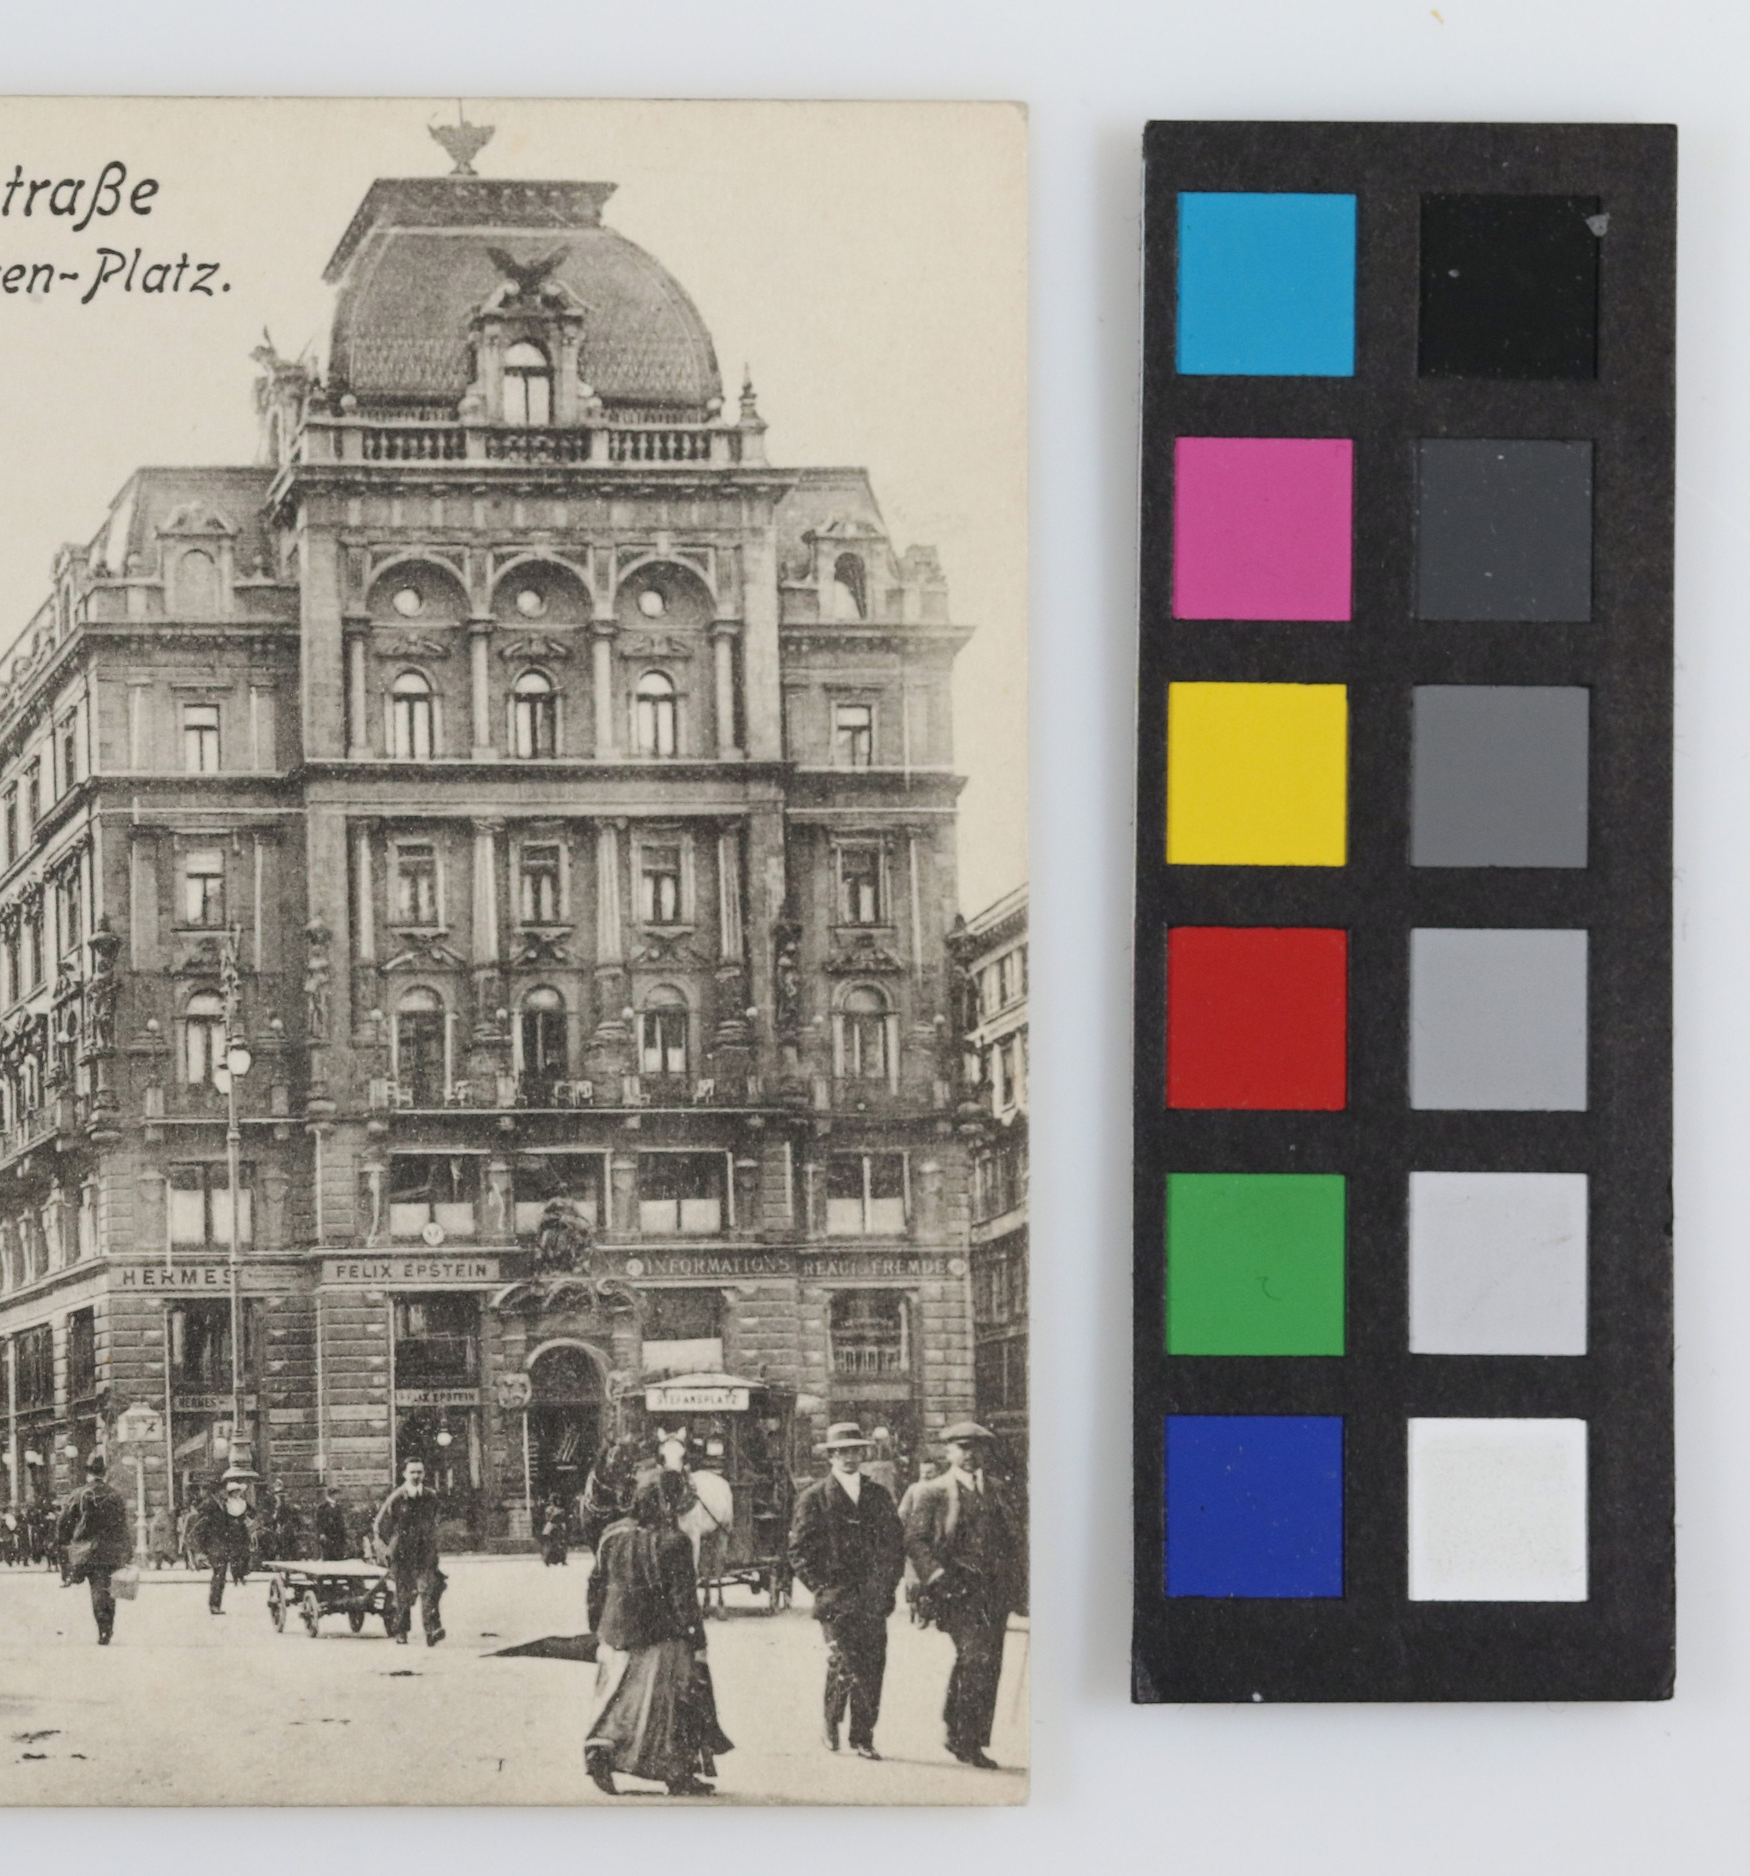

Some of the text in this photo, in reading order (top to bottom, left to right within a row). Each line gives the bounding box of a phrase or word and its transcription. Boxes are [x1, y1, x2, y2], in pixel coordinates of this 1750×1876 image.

[336, 1262, 488, 1279] FELIX EPSTEIN
[646, 1256, 791, 1275] INFORMATIONS
[122, 1266, 237, 1287] HERMES
